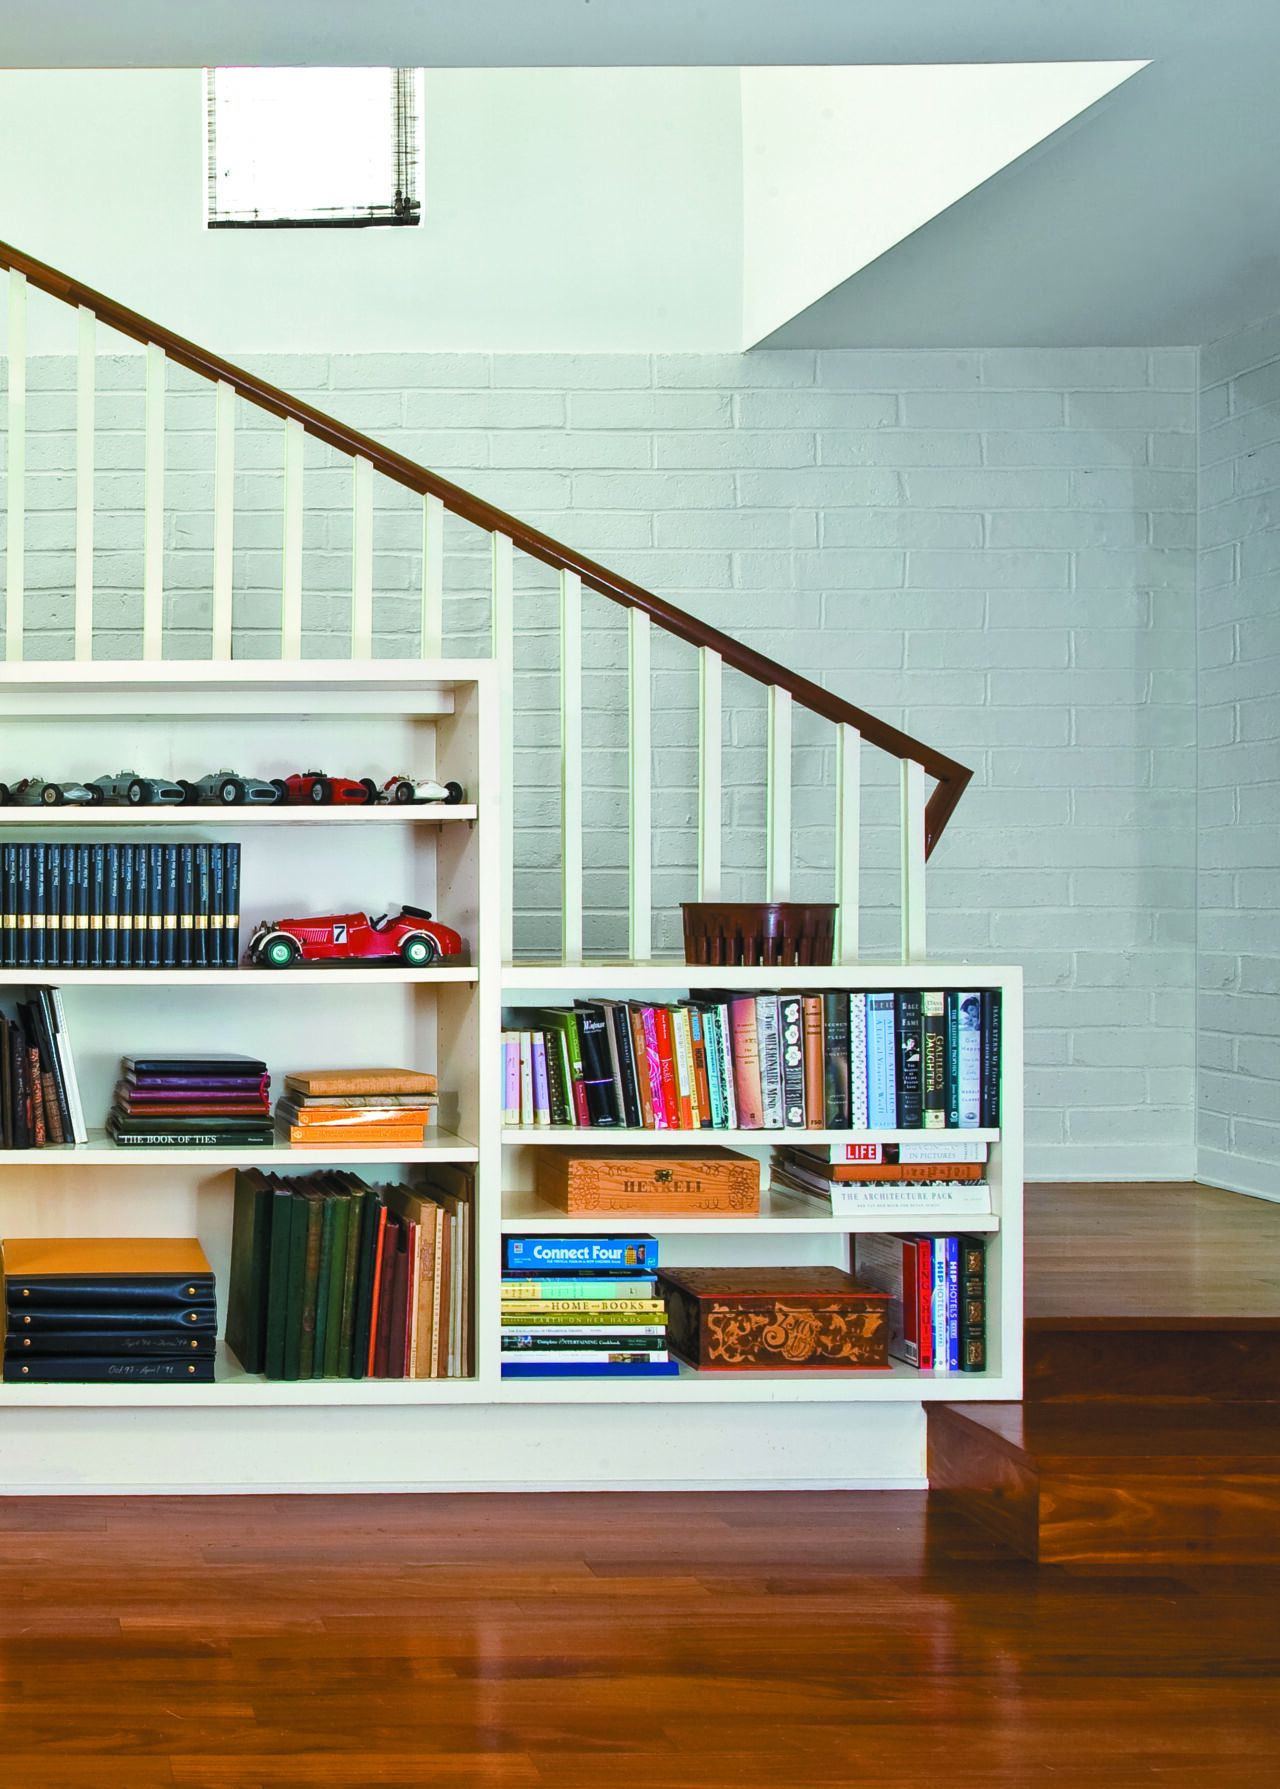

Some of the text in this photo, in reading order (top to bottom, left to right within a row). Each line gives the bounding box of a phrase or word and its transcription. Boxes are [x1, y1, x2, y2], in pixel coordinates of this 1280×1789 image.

[334, 925, 346, 942] 7
[765, 1015, 778, 1110] THE MILLIONAIRE MIND
[926, 1032, 936, 1093] DAUGHTER
[936, 1035, 945, 1090] GALILEO'S
[123, 1135, 217, 1144] THE BOOK OF TIES
[847, 1145, 875, 1159] LIFE
[919, 1152, 956, 1160] PICTURES
[623, 1180, 705, 1193] HENKELL
[841, 1192, 953, 1201] THE ARCHITECTURE PACK
[533, 1245, 623, 1259] Connect Four
[551, 1301, 590, 1310] HOME
[601, 1301, 645, 1310] BOOKS
